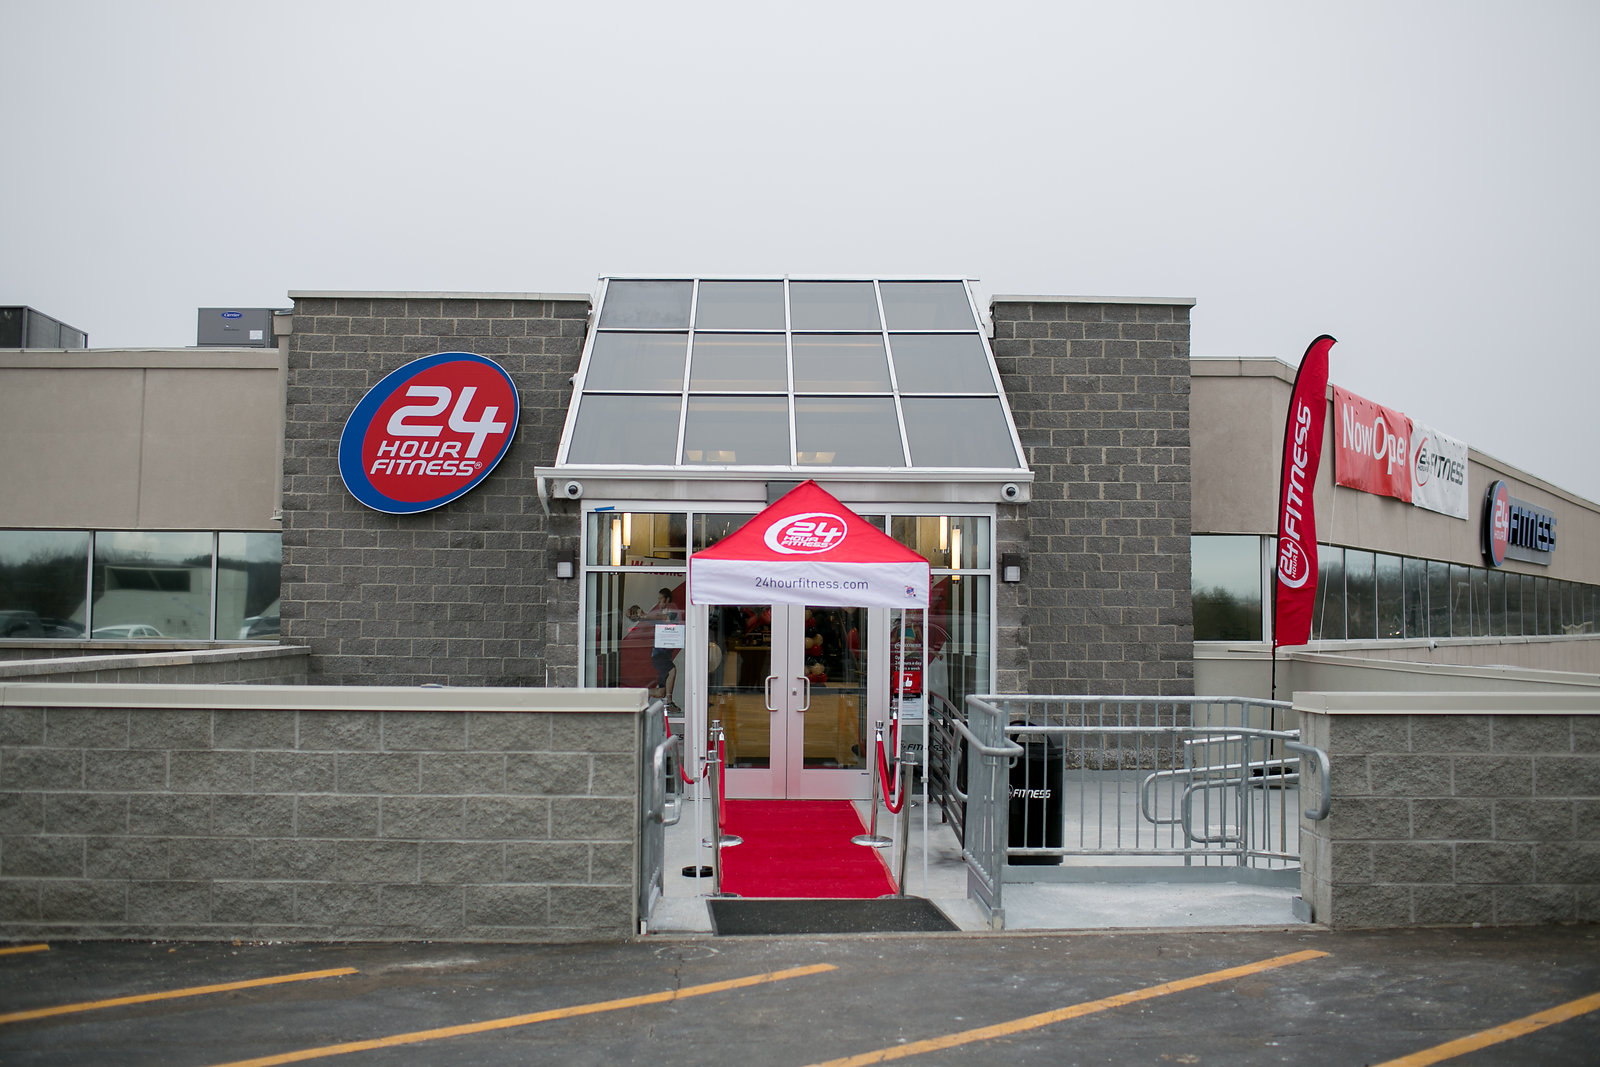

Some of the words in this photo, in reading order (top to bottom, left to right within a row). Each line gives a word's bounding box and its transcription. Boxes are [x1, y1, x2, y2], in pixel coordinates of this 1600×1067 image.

[386, 385, 507, 458] 24
[377, 440, 462, 458] HOUR
[1373, 416, 1407, 475] Ope
[1284, 397, 1312, 541] FITNESS
[1431, 453, 1465, 486] FITNESS
[786, 522, 842, 542] 24
[1494, 499, 1509, 541] 24
[1509, 505, 1557, 553] FITNESS
[1280, 542, 1299, 575] 24
[755, 577, 869, 590] 24hourfitness.com
[1013, 788, 1051, 799] FITNESS
